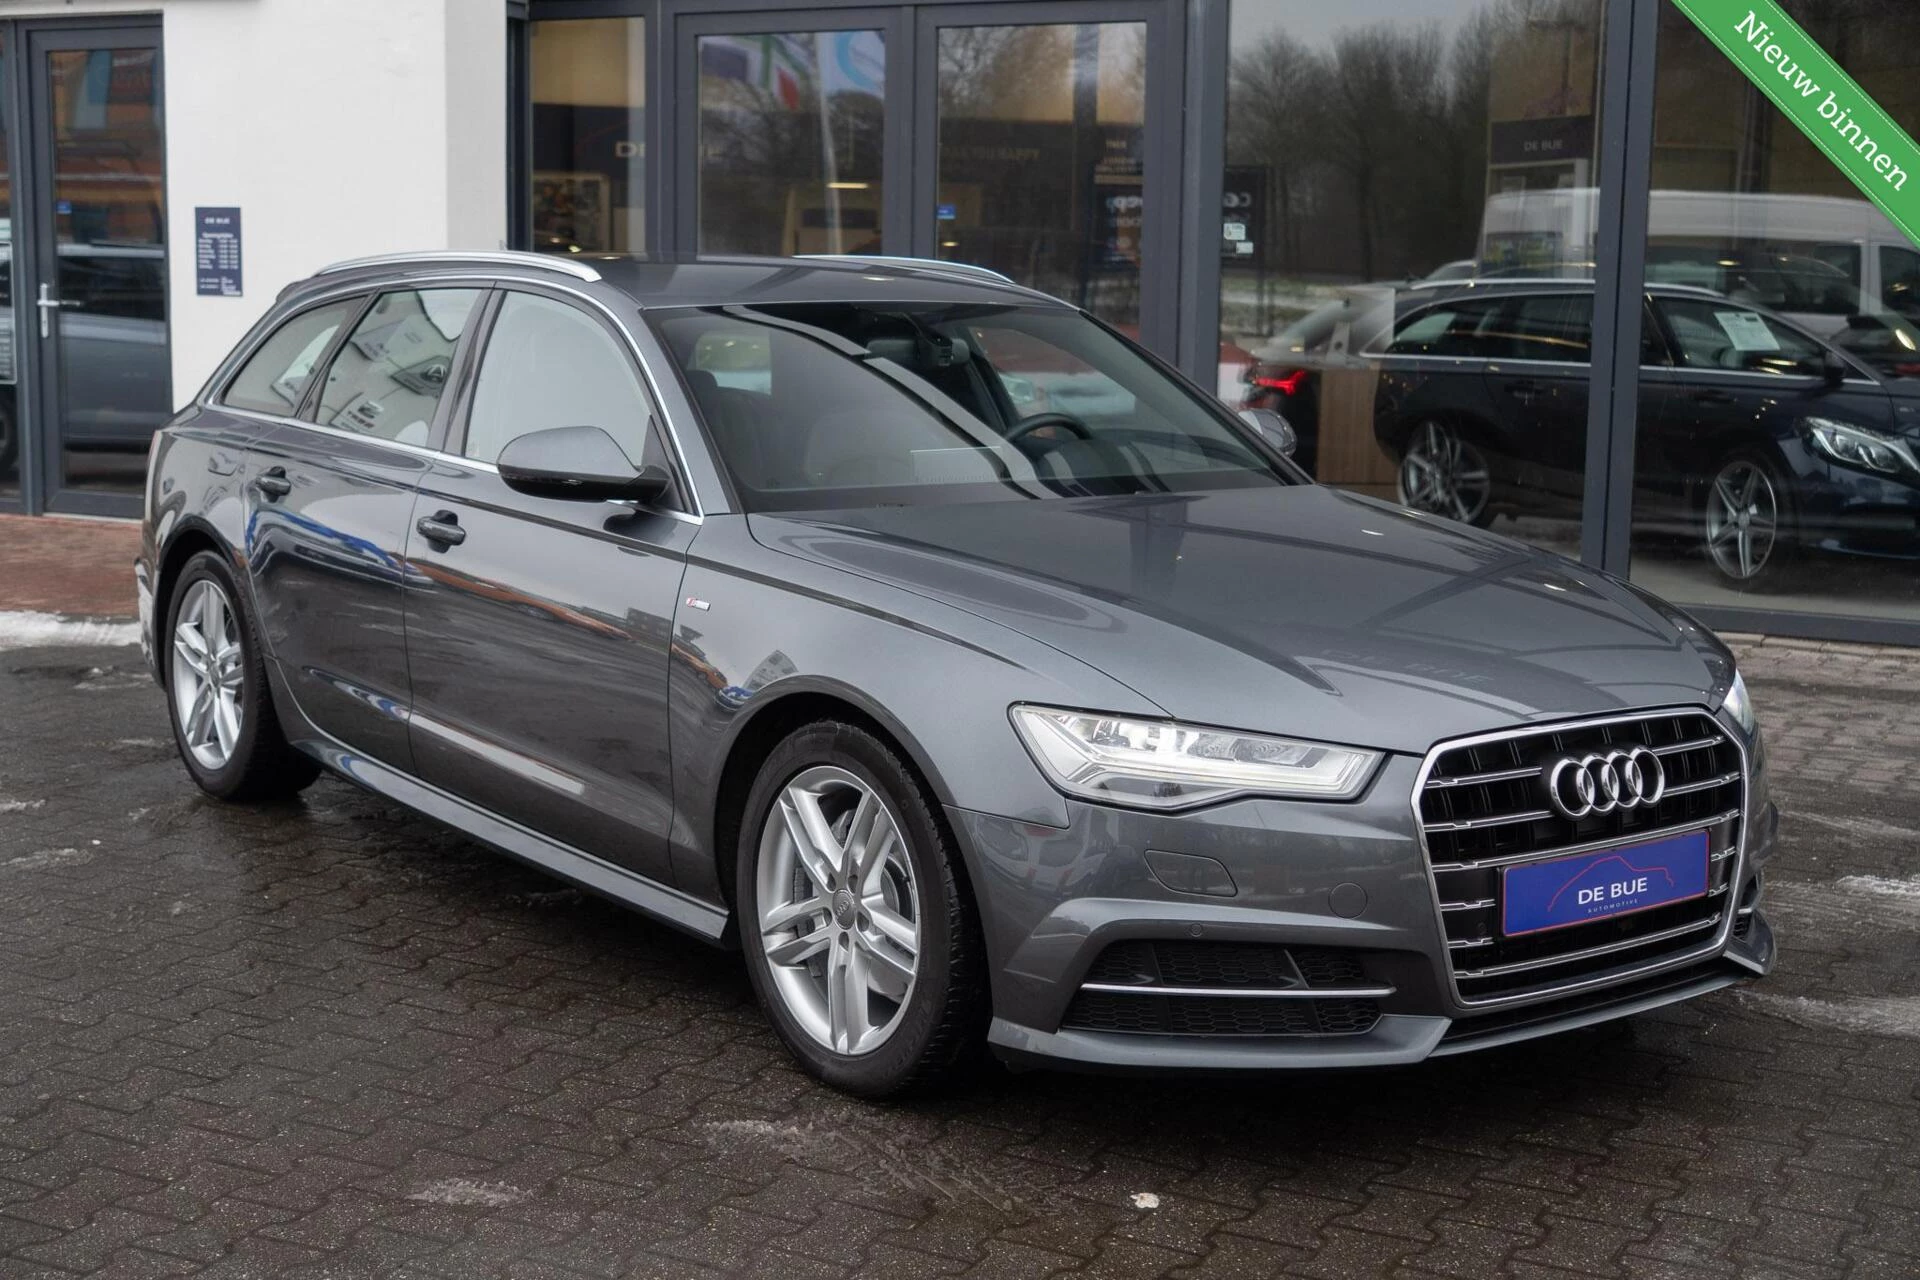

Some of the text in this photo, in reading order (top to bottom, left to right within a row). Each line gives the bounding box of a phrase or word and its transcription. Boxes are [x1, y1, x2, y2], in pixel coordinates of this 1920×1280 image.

[1578, 877, 1648, 905] DE BUE
[1588, 898, 1638, 914] AUTOMOTIVE
